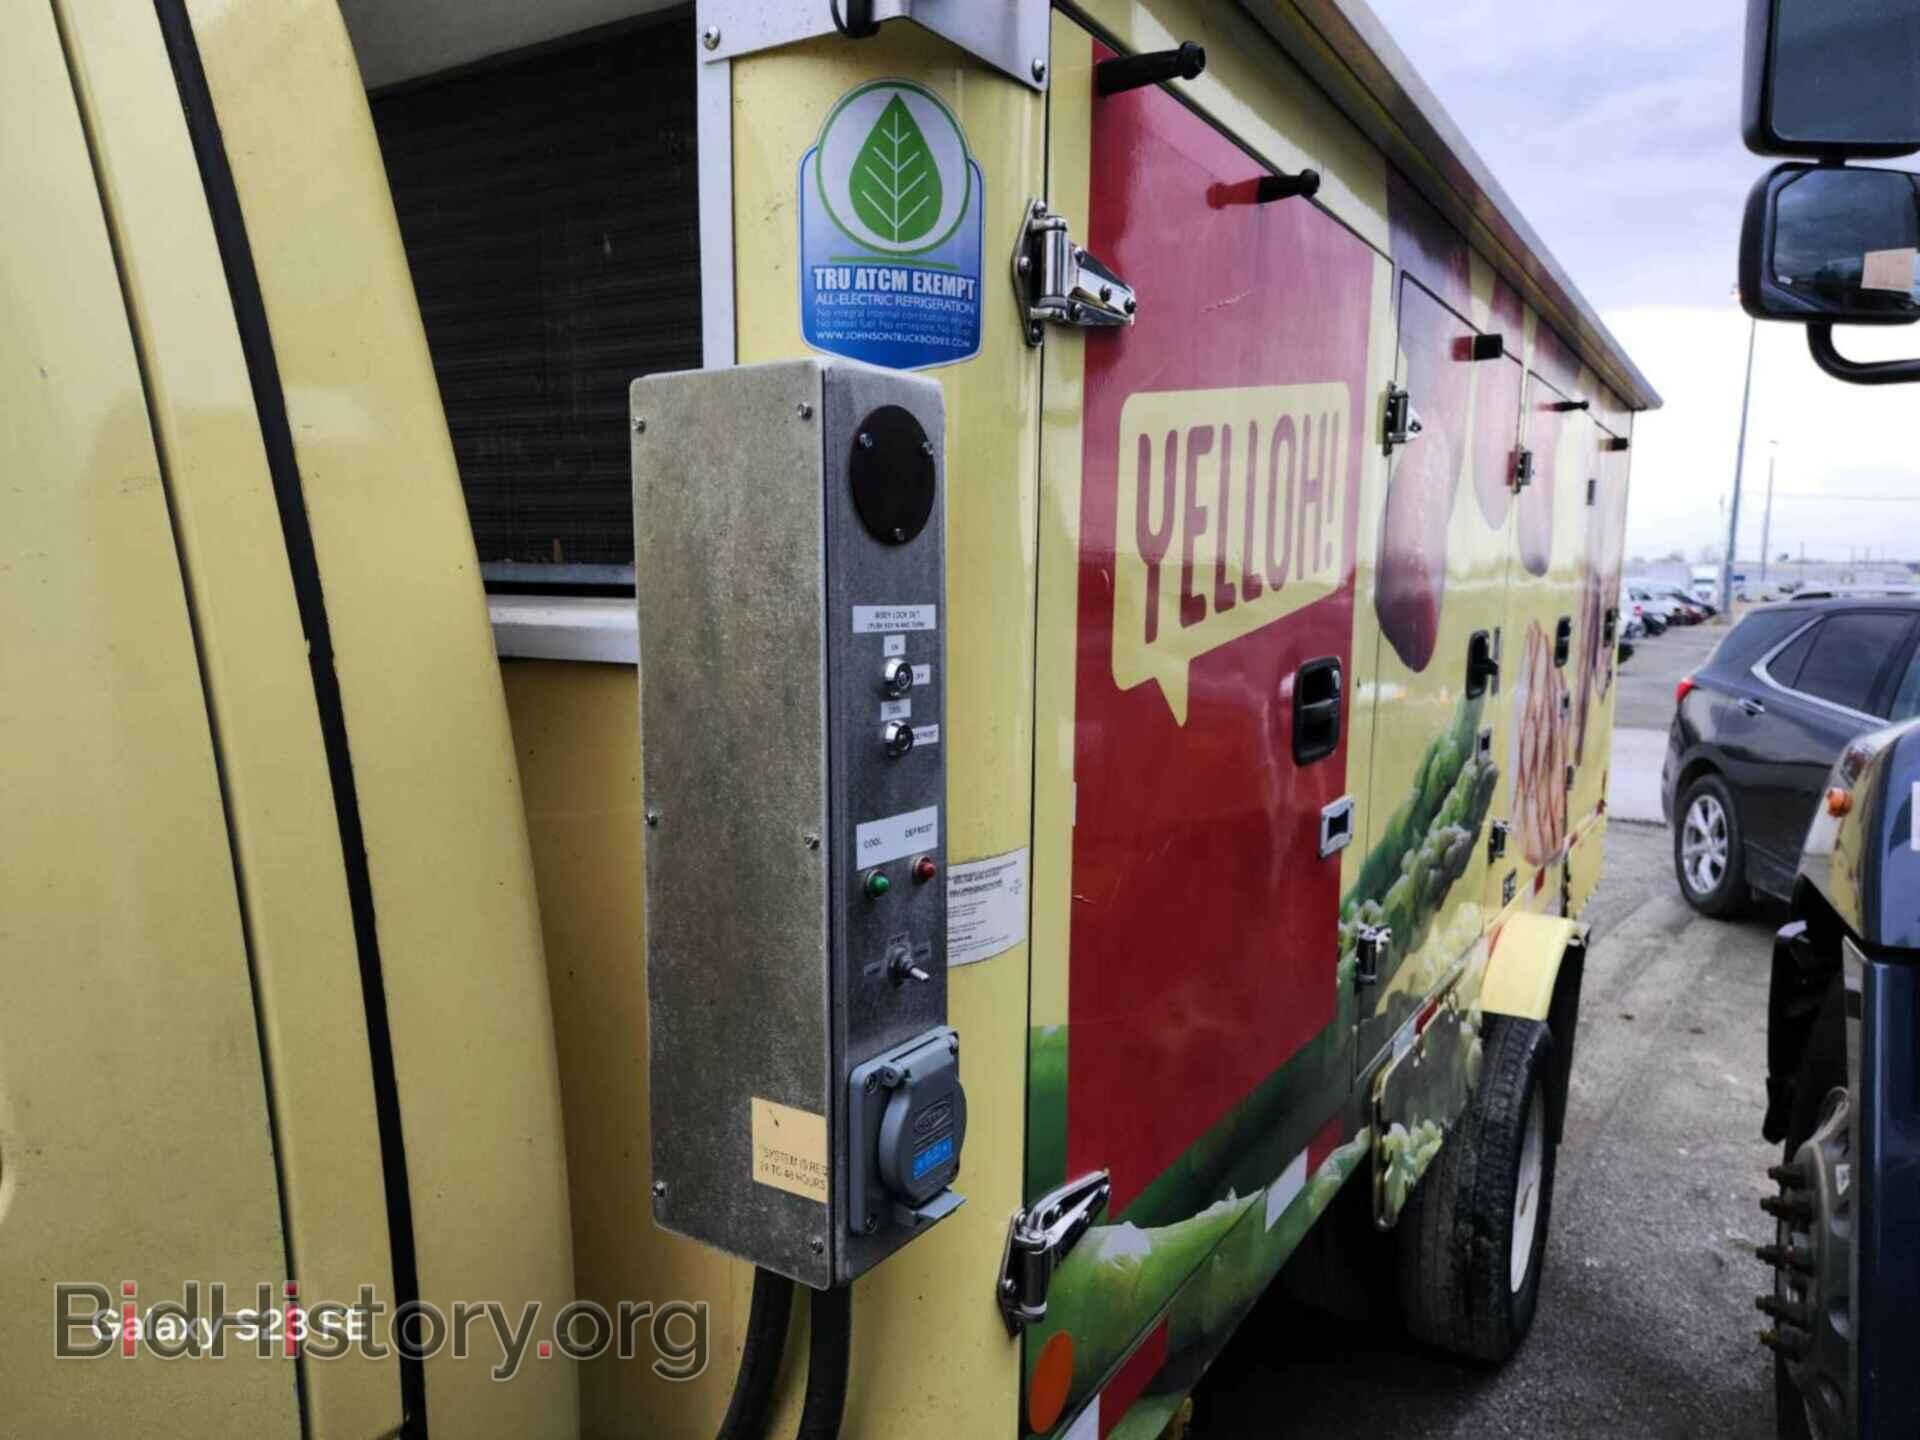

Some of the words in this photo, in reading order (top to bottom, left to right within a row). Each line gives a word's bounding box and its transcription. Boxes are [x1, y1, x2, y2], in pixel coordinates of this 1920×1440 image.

[814, 267, 850, 291] TRU
[855, 268, 908, 292] ATCM
[912, 271, 976, 300] EXEMPT
[815, 292, 893, 307] ALL-ELECTRIC
[895, 295, 975, 315] REFRIGERATION
[1135, 412, 1340, 645] YELLOH!
[863, 837, 882, 850] COOL
